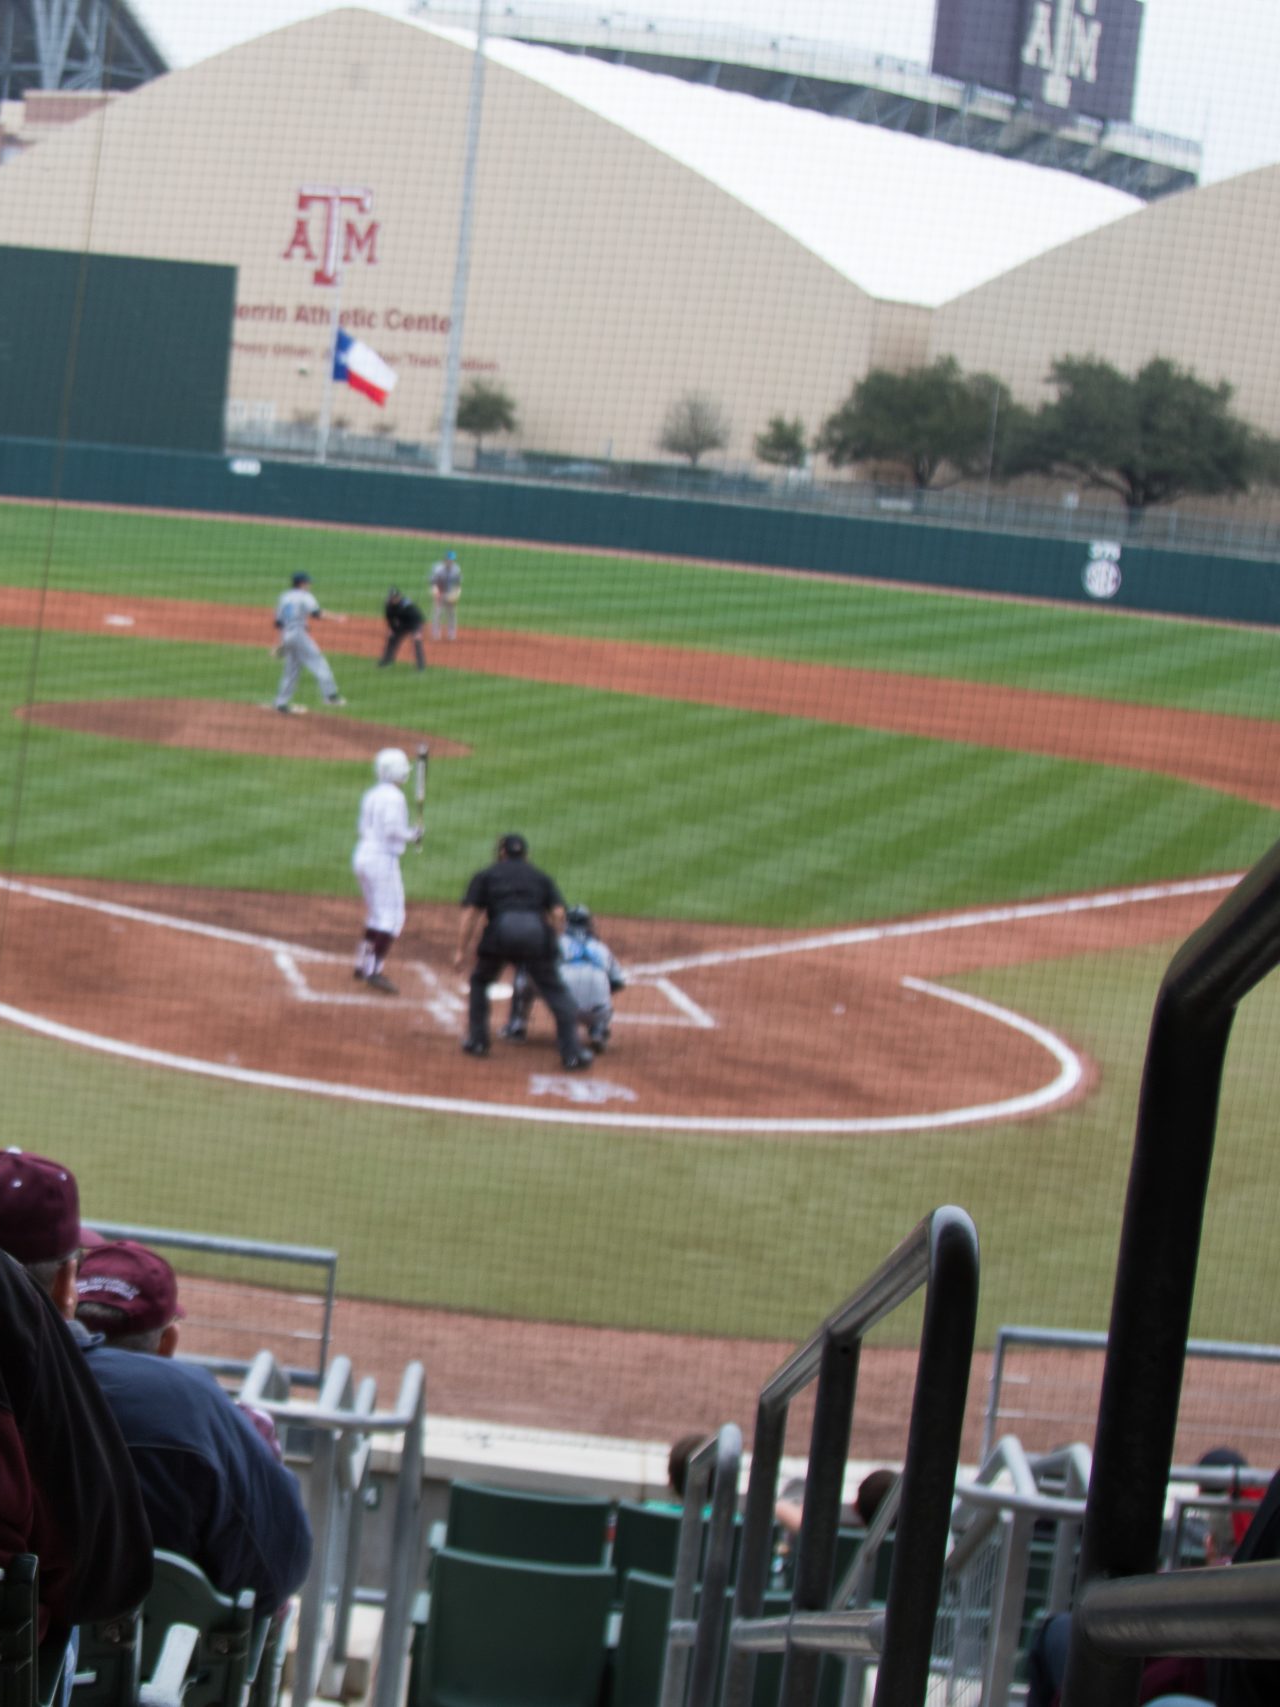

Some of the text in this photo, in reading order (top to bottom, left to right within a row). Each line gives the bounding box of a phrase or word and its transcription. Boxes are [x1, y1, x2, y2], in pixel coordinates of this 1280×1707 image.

[235, 302, 453, 334] errin Athetic Cente
